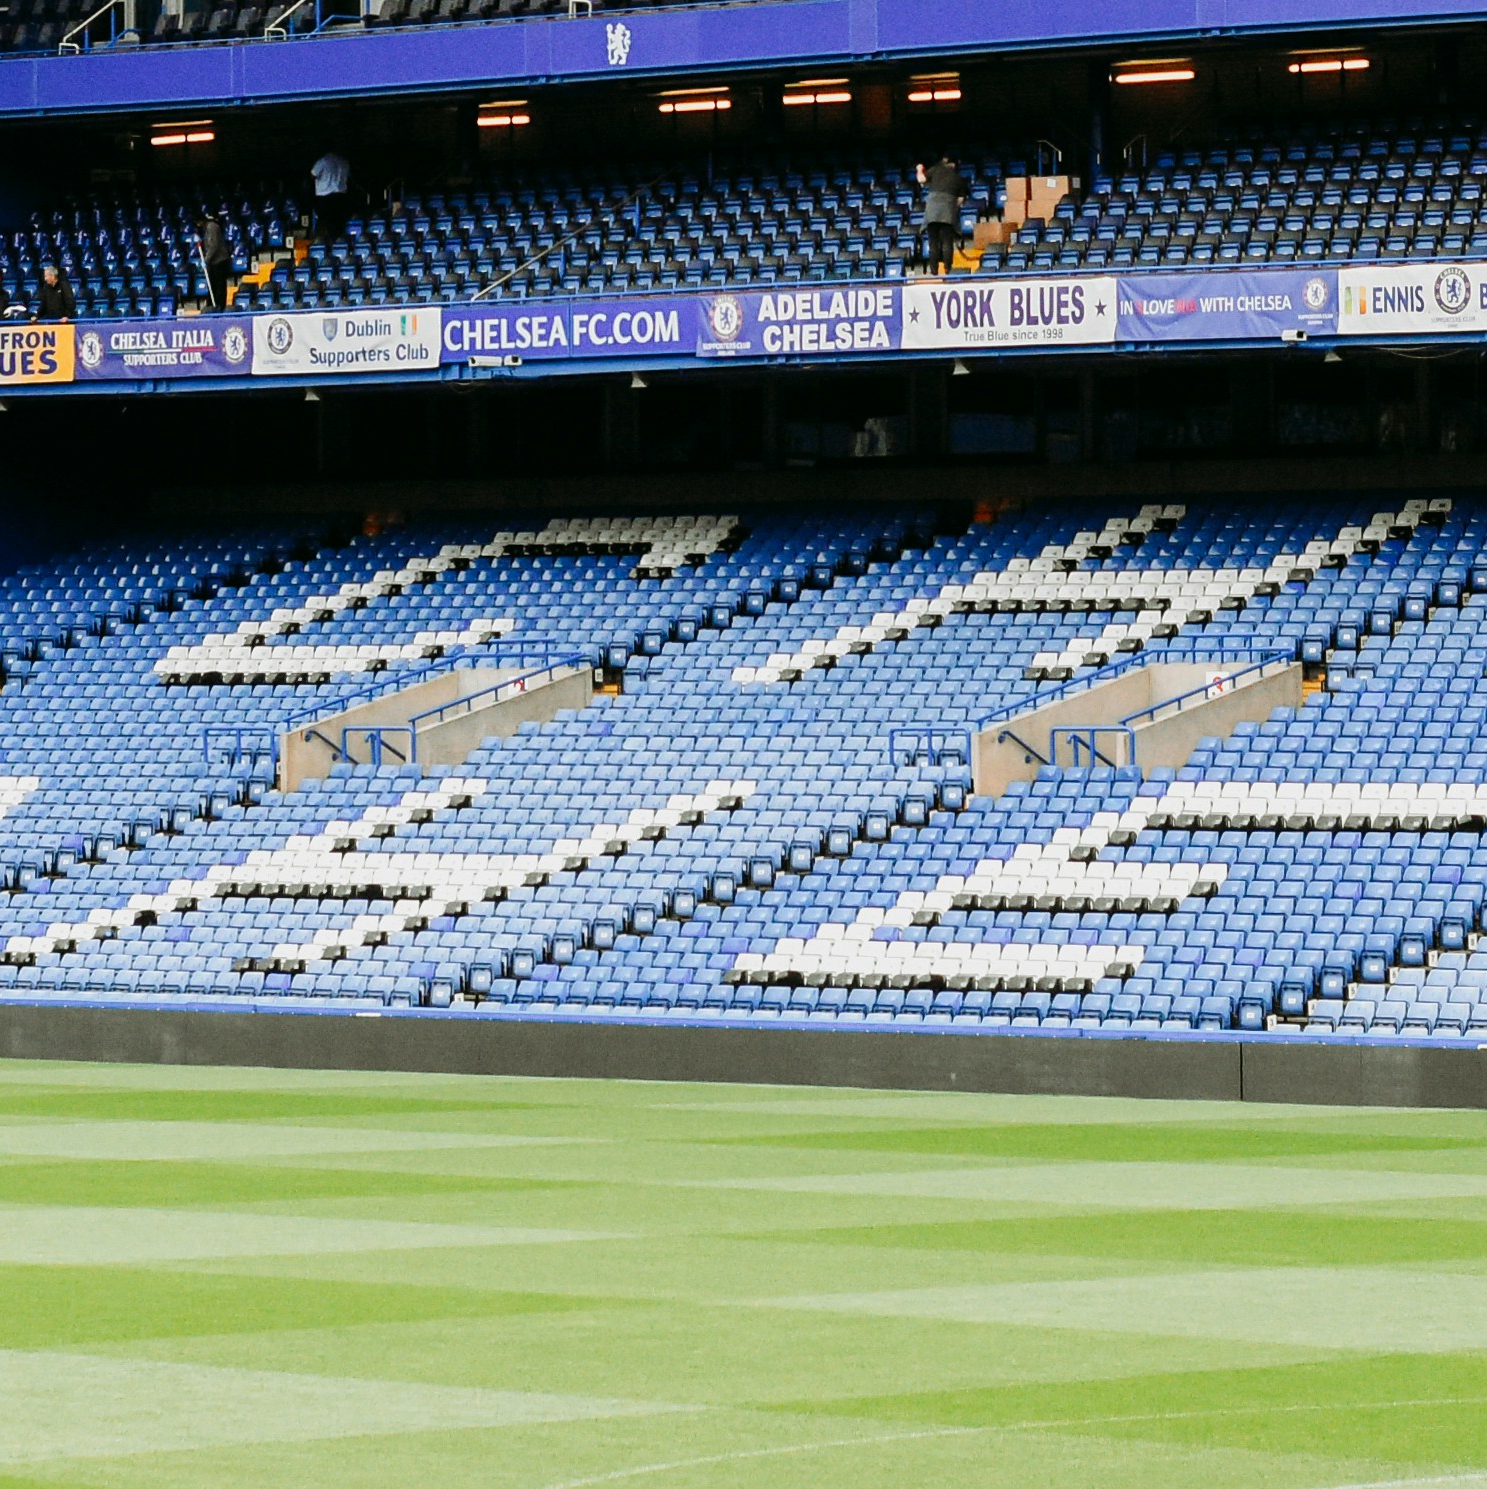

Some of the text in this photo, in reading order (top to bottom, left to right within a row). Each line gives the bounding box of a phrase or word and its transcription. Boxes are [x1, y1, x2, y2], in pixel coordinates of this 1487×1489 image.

[758, 290, 893, 321] ADELAIDE
[931, 285, 1085, 329] YORK BLUES
[1120, 301, 1133, 315] IN
[1200, 297, 1233, 312] WITH
[1237, 295, 1291, 310] CHELSEA
[1372, 286, 1424, 313] ENNIS
[345, 320, 391, 337] Dublin
[763, 321, 890, 352] CHELSEA
[964, 329, 1063, 341] True Blue since 1998
[111, 330, 213, 349] CHELSEA ITALIA
[123, 352, 202, 366] SUPPORTERS CLUB
[310, 347, 390, 366] Supporters
[396, 344, 428, 361] Club
